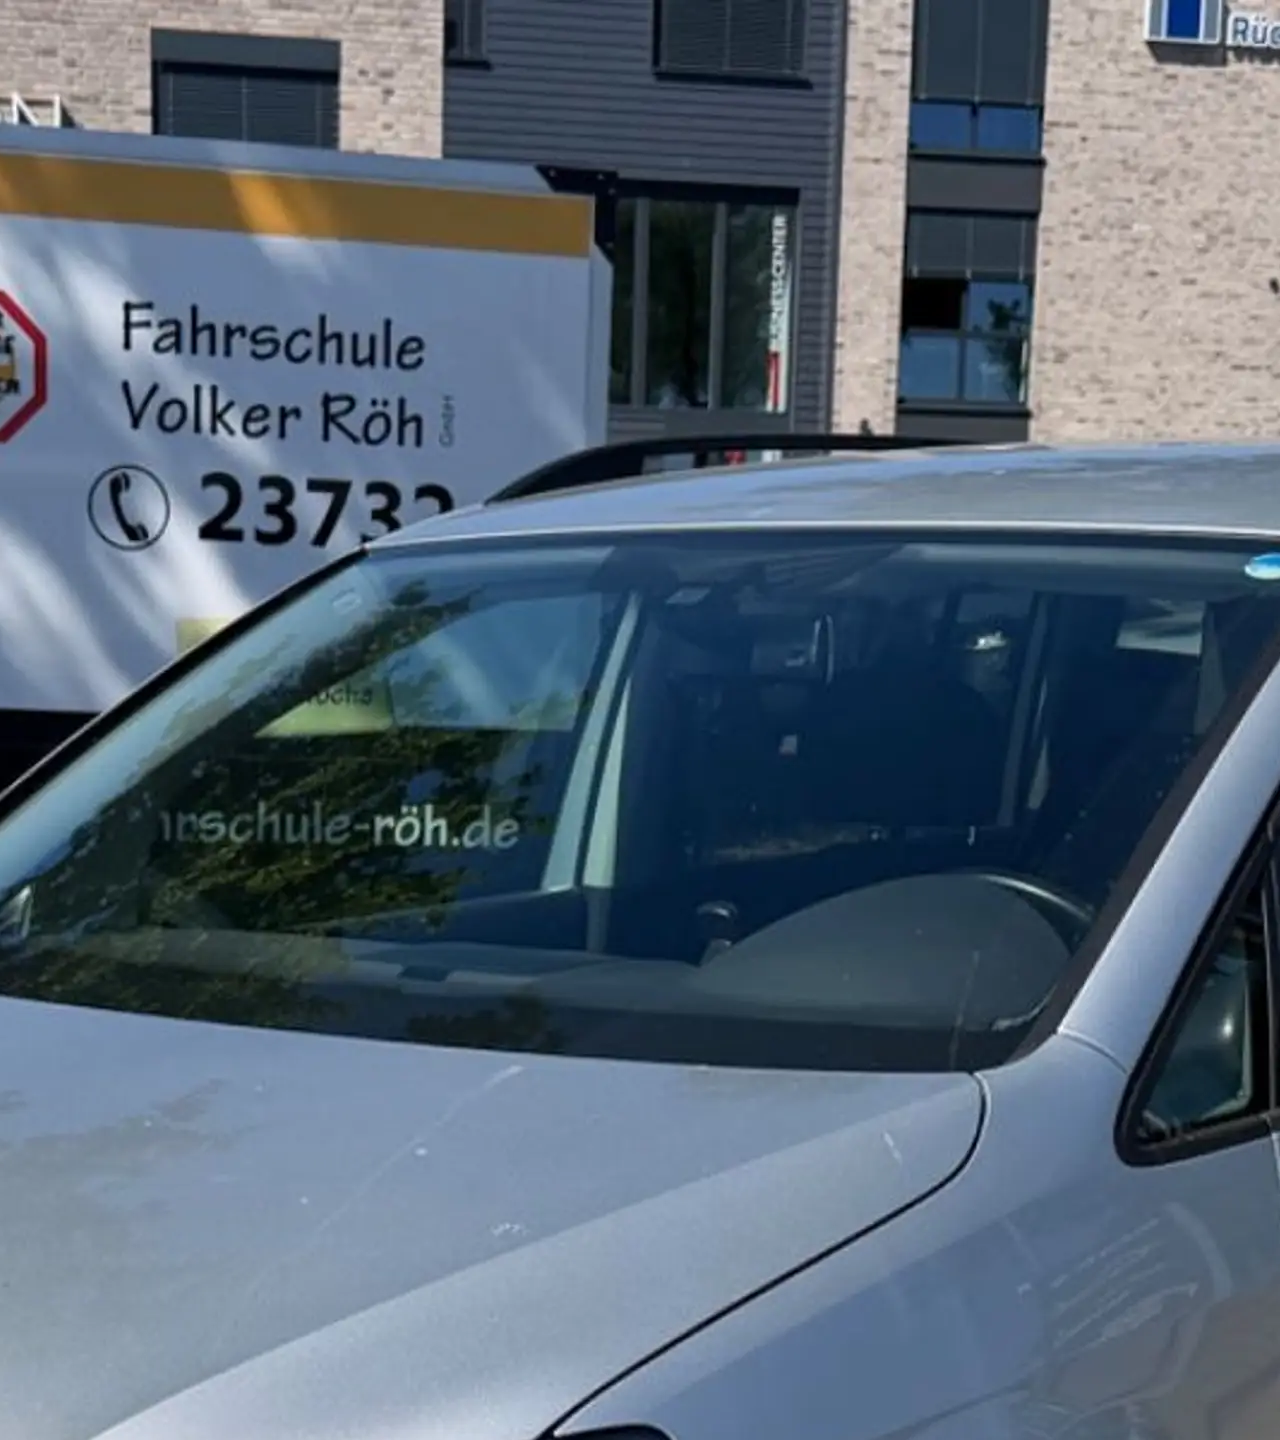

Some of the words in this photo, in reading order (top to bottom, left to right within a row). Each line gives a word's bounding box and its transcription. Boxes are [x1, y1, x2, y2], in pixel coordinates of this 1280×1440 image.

[122, 300, 426, 371] Fahrschule
[122, 380, 302, 441] Volker
[321, 391, 425, 449] Röh
